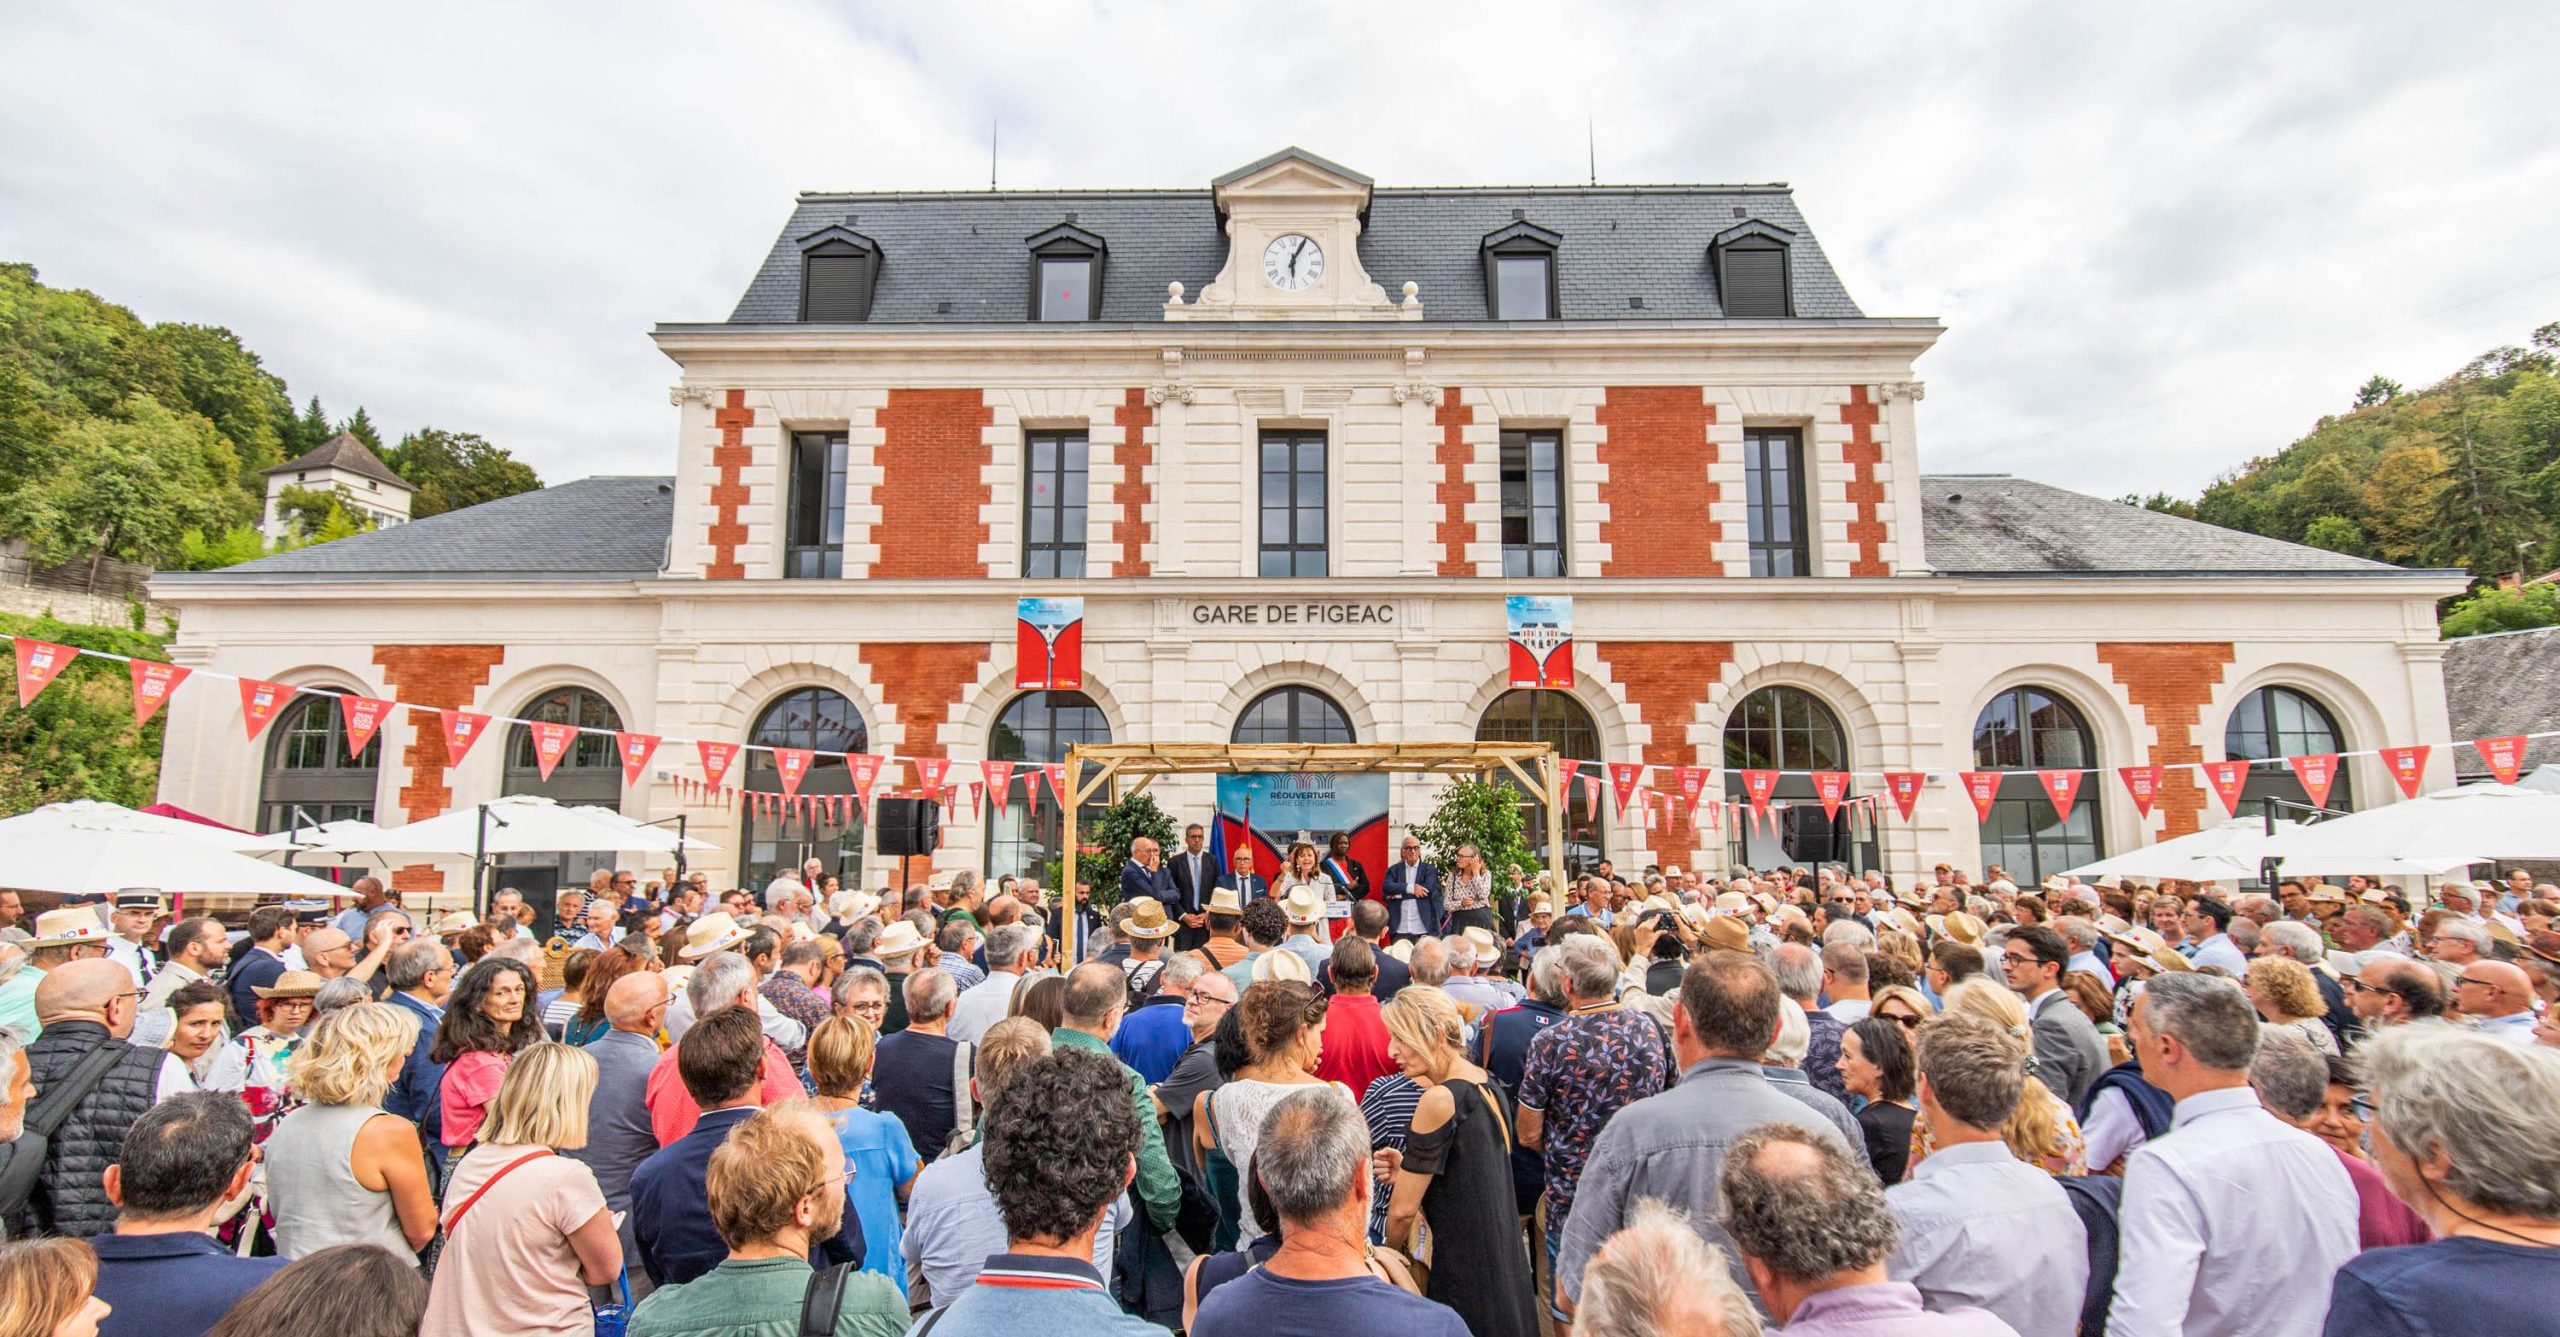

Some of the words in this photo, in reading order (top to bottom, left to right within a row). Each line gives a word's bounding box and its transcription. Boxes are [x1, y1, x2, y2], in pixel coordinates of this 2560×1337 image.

[1193, 605, 1258, 623] GARE
[1267, 605, 1298, 623] DE
[1306, 605, 1393, 623] FIGEAC
[1270, 790, 1336, 799] RÉOUVERTURE
